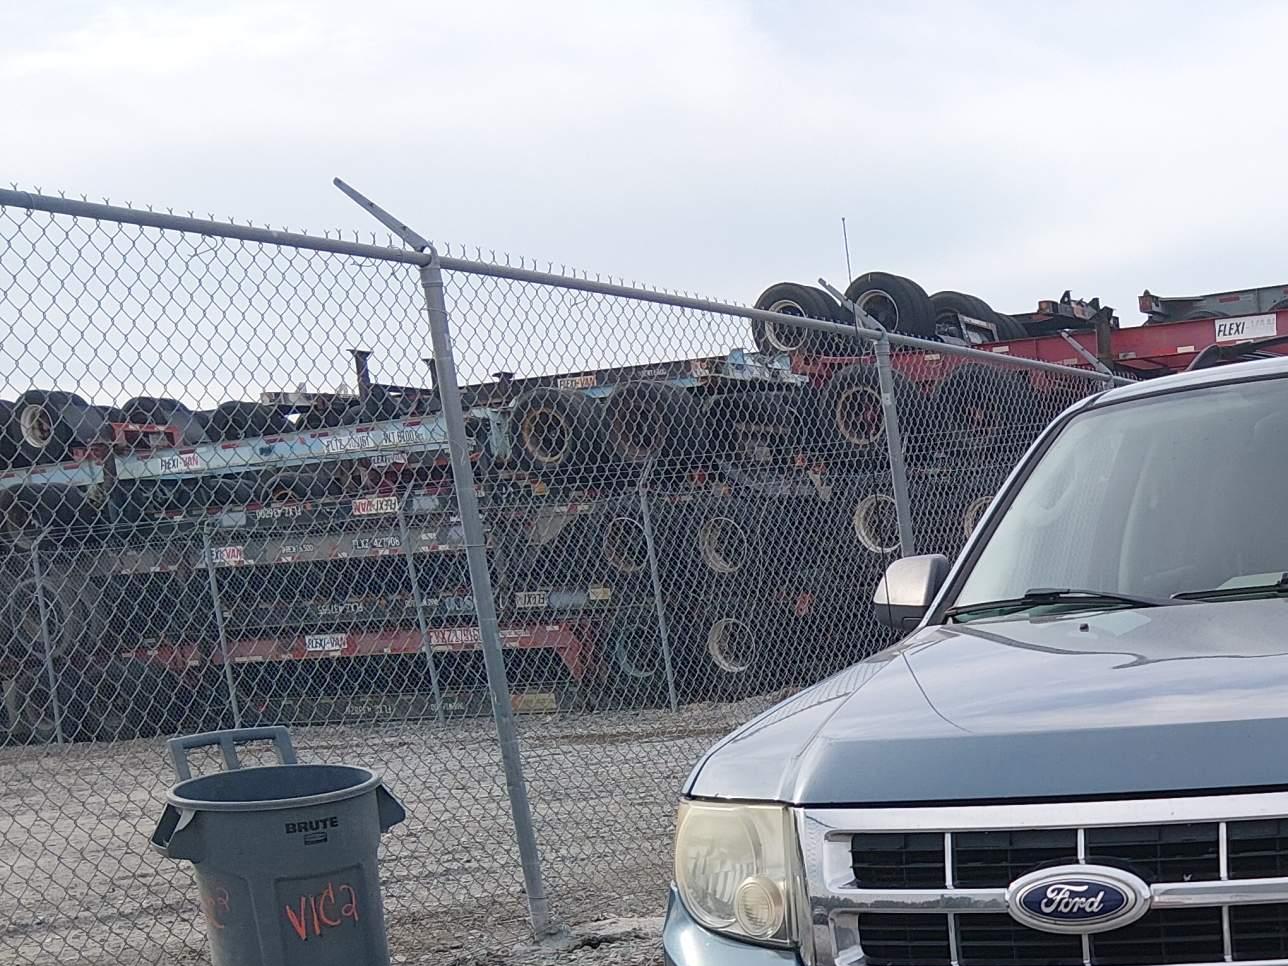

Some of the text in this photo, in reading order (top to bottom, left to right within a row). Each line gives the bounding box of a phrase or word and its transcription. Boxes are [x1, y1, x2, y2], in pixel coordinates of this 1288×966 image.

[160, 456, 199, 472] FLEXI-VAN
[353, 498, 397, 513] FLEXI-VAN
[285, 816, 339, 834] BRUTE
[1040, 884, 1105, 913] Ford
